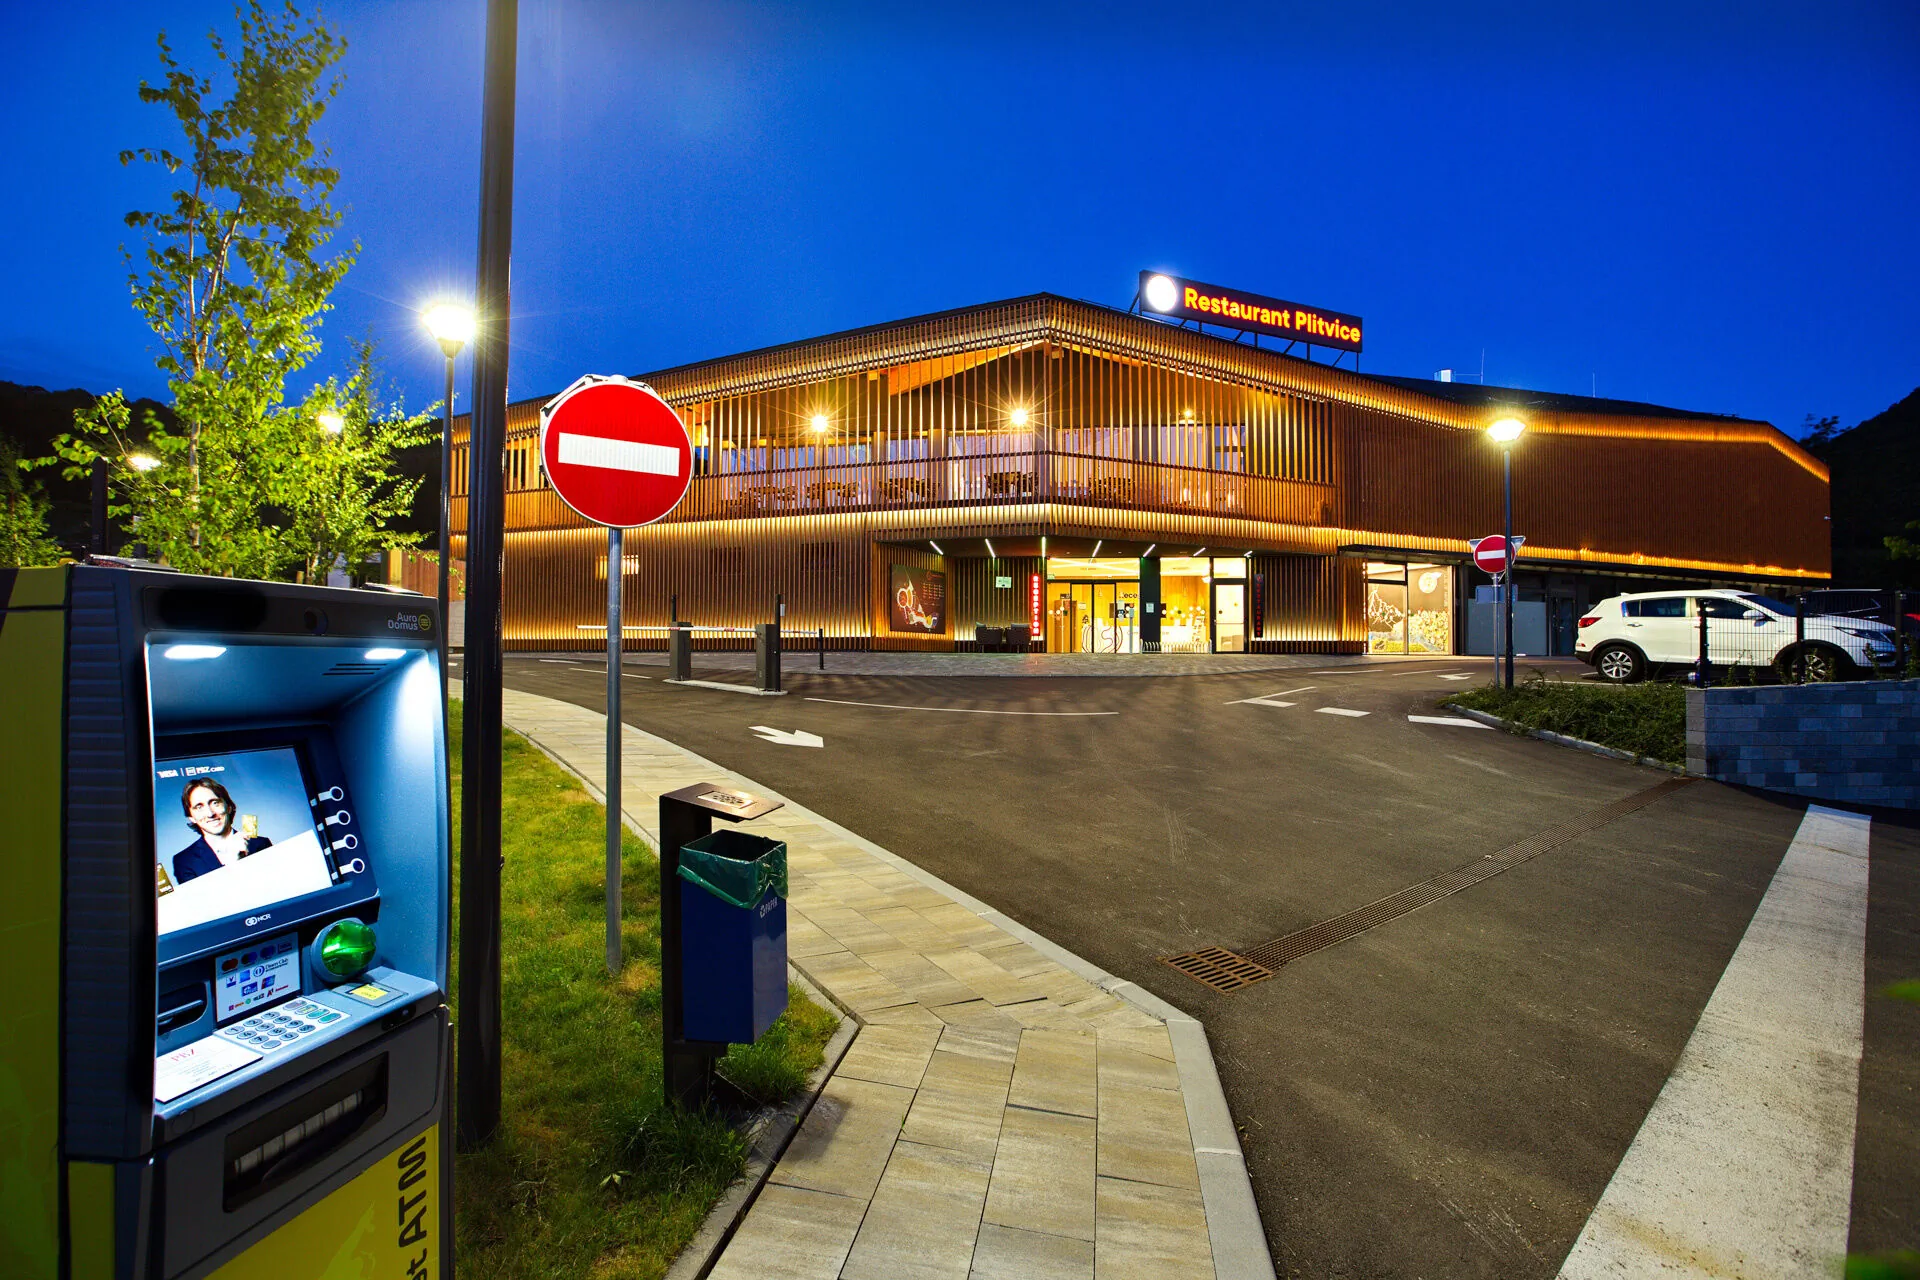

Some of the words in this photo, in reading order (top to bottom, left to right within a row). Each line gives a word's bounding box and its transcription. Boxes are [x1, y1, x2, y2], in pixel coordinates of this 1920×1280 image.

[1184, 286, 1291, 328] Restaurant
[1295, 310, 1361, 343] Plitvice
[397, 611, 418, 622] Auro
[1032, 575, 1040, 635] RECEPTION
[387, 619, 418, 630] Domus
[257, 913, 272, 922] NCR
[397, 1136, 427, 1248] ATM
